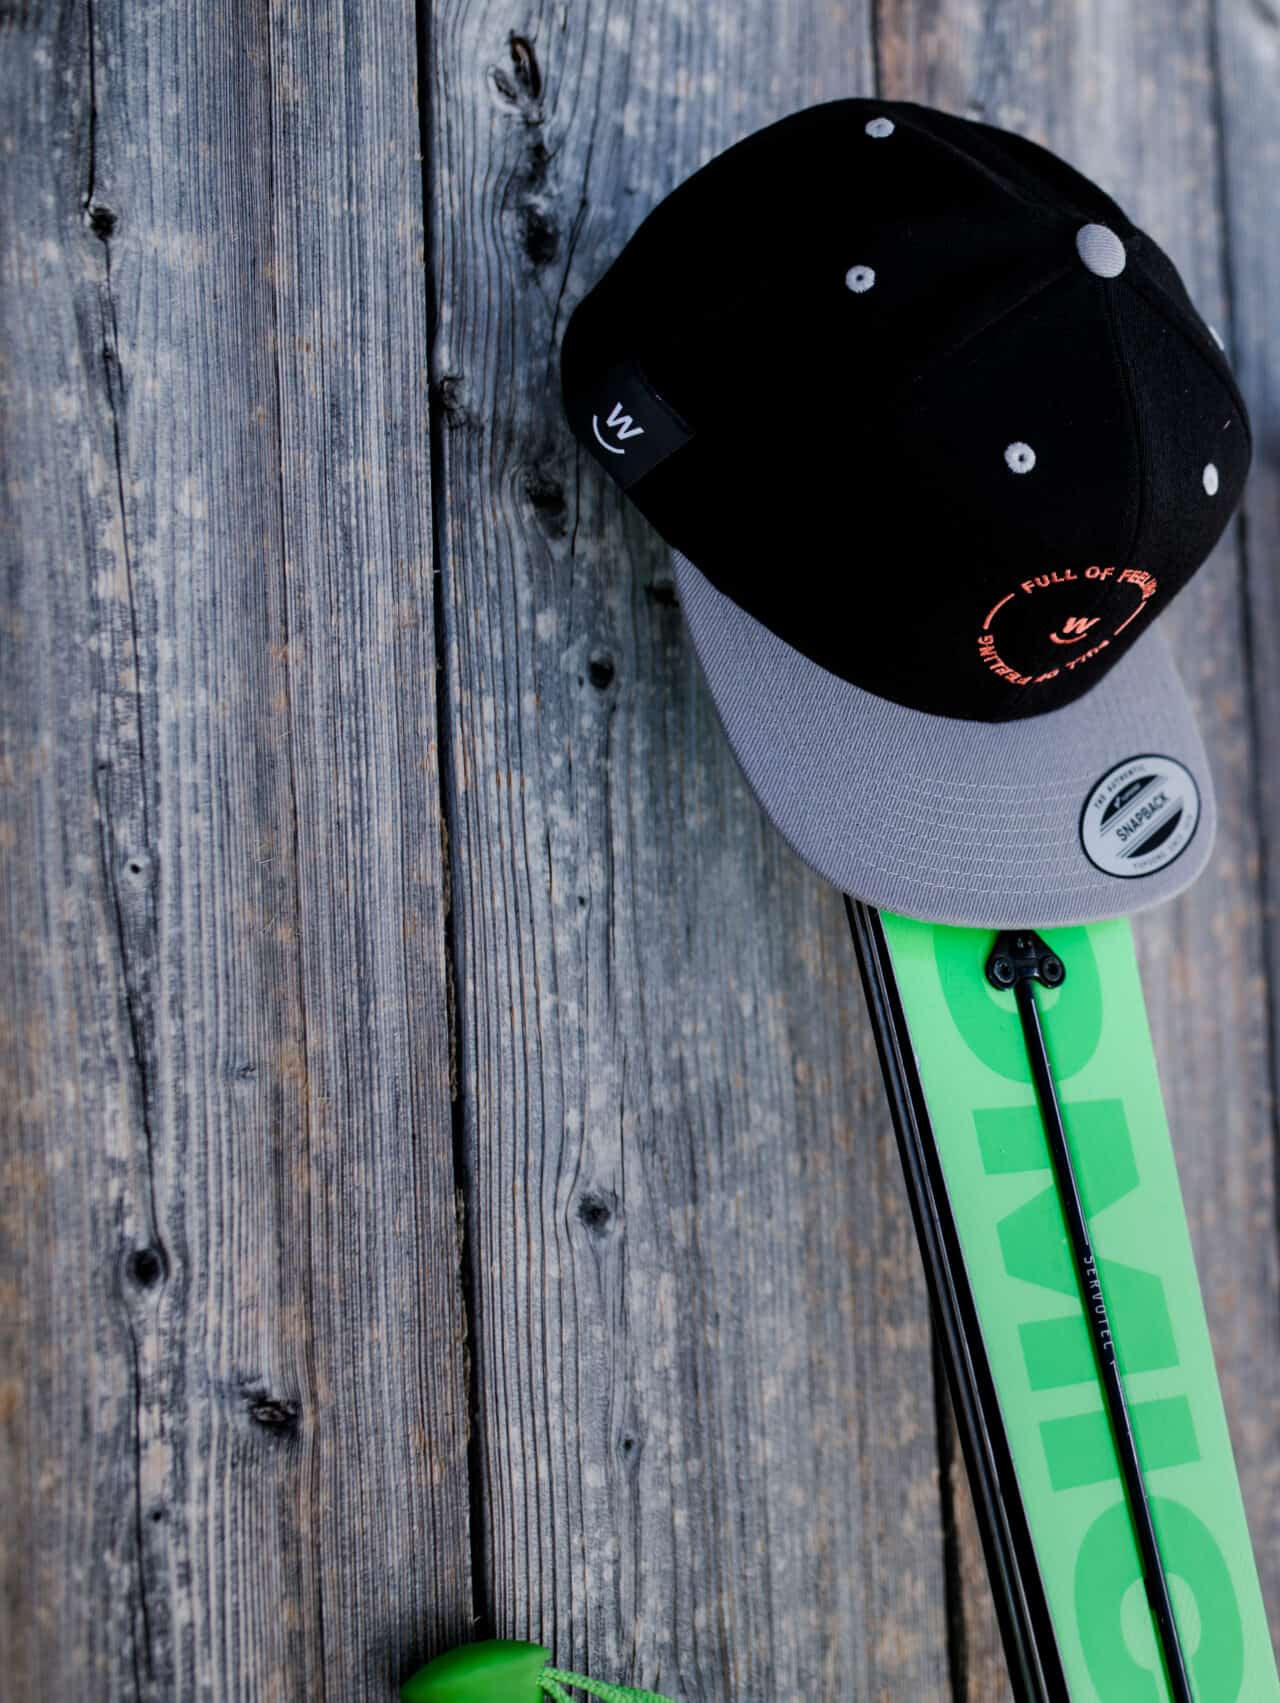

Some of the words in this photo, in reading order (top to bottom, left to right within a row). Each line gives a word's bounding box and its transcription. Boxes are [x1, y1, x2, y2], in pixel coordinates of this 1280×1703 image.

[606, 401, 645, 441] W
[1020, 569, 1079, 594] FULL
[1084, 566, 1116, 581] OF
[977, 633, 1033, 686] FEELING
[1115, 791, 1169, 842] SNAPBACK
